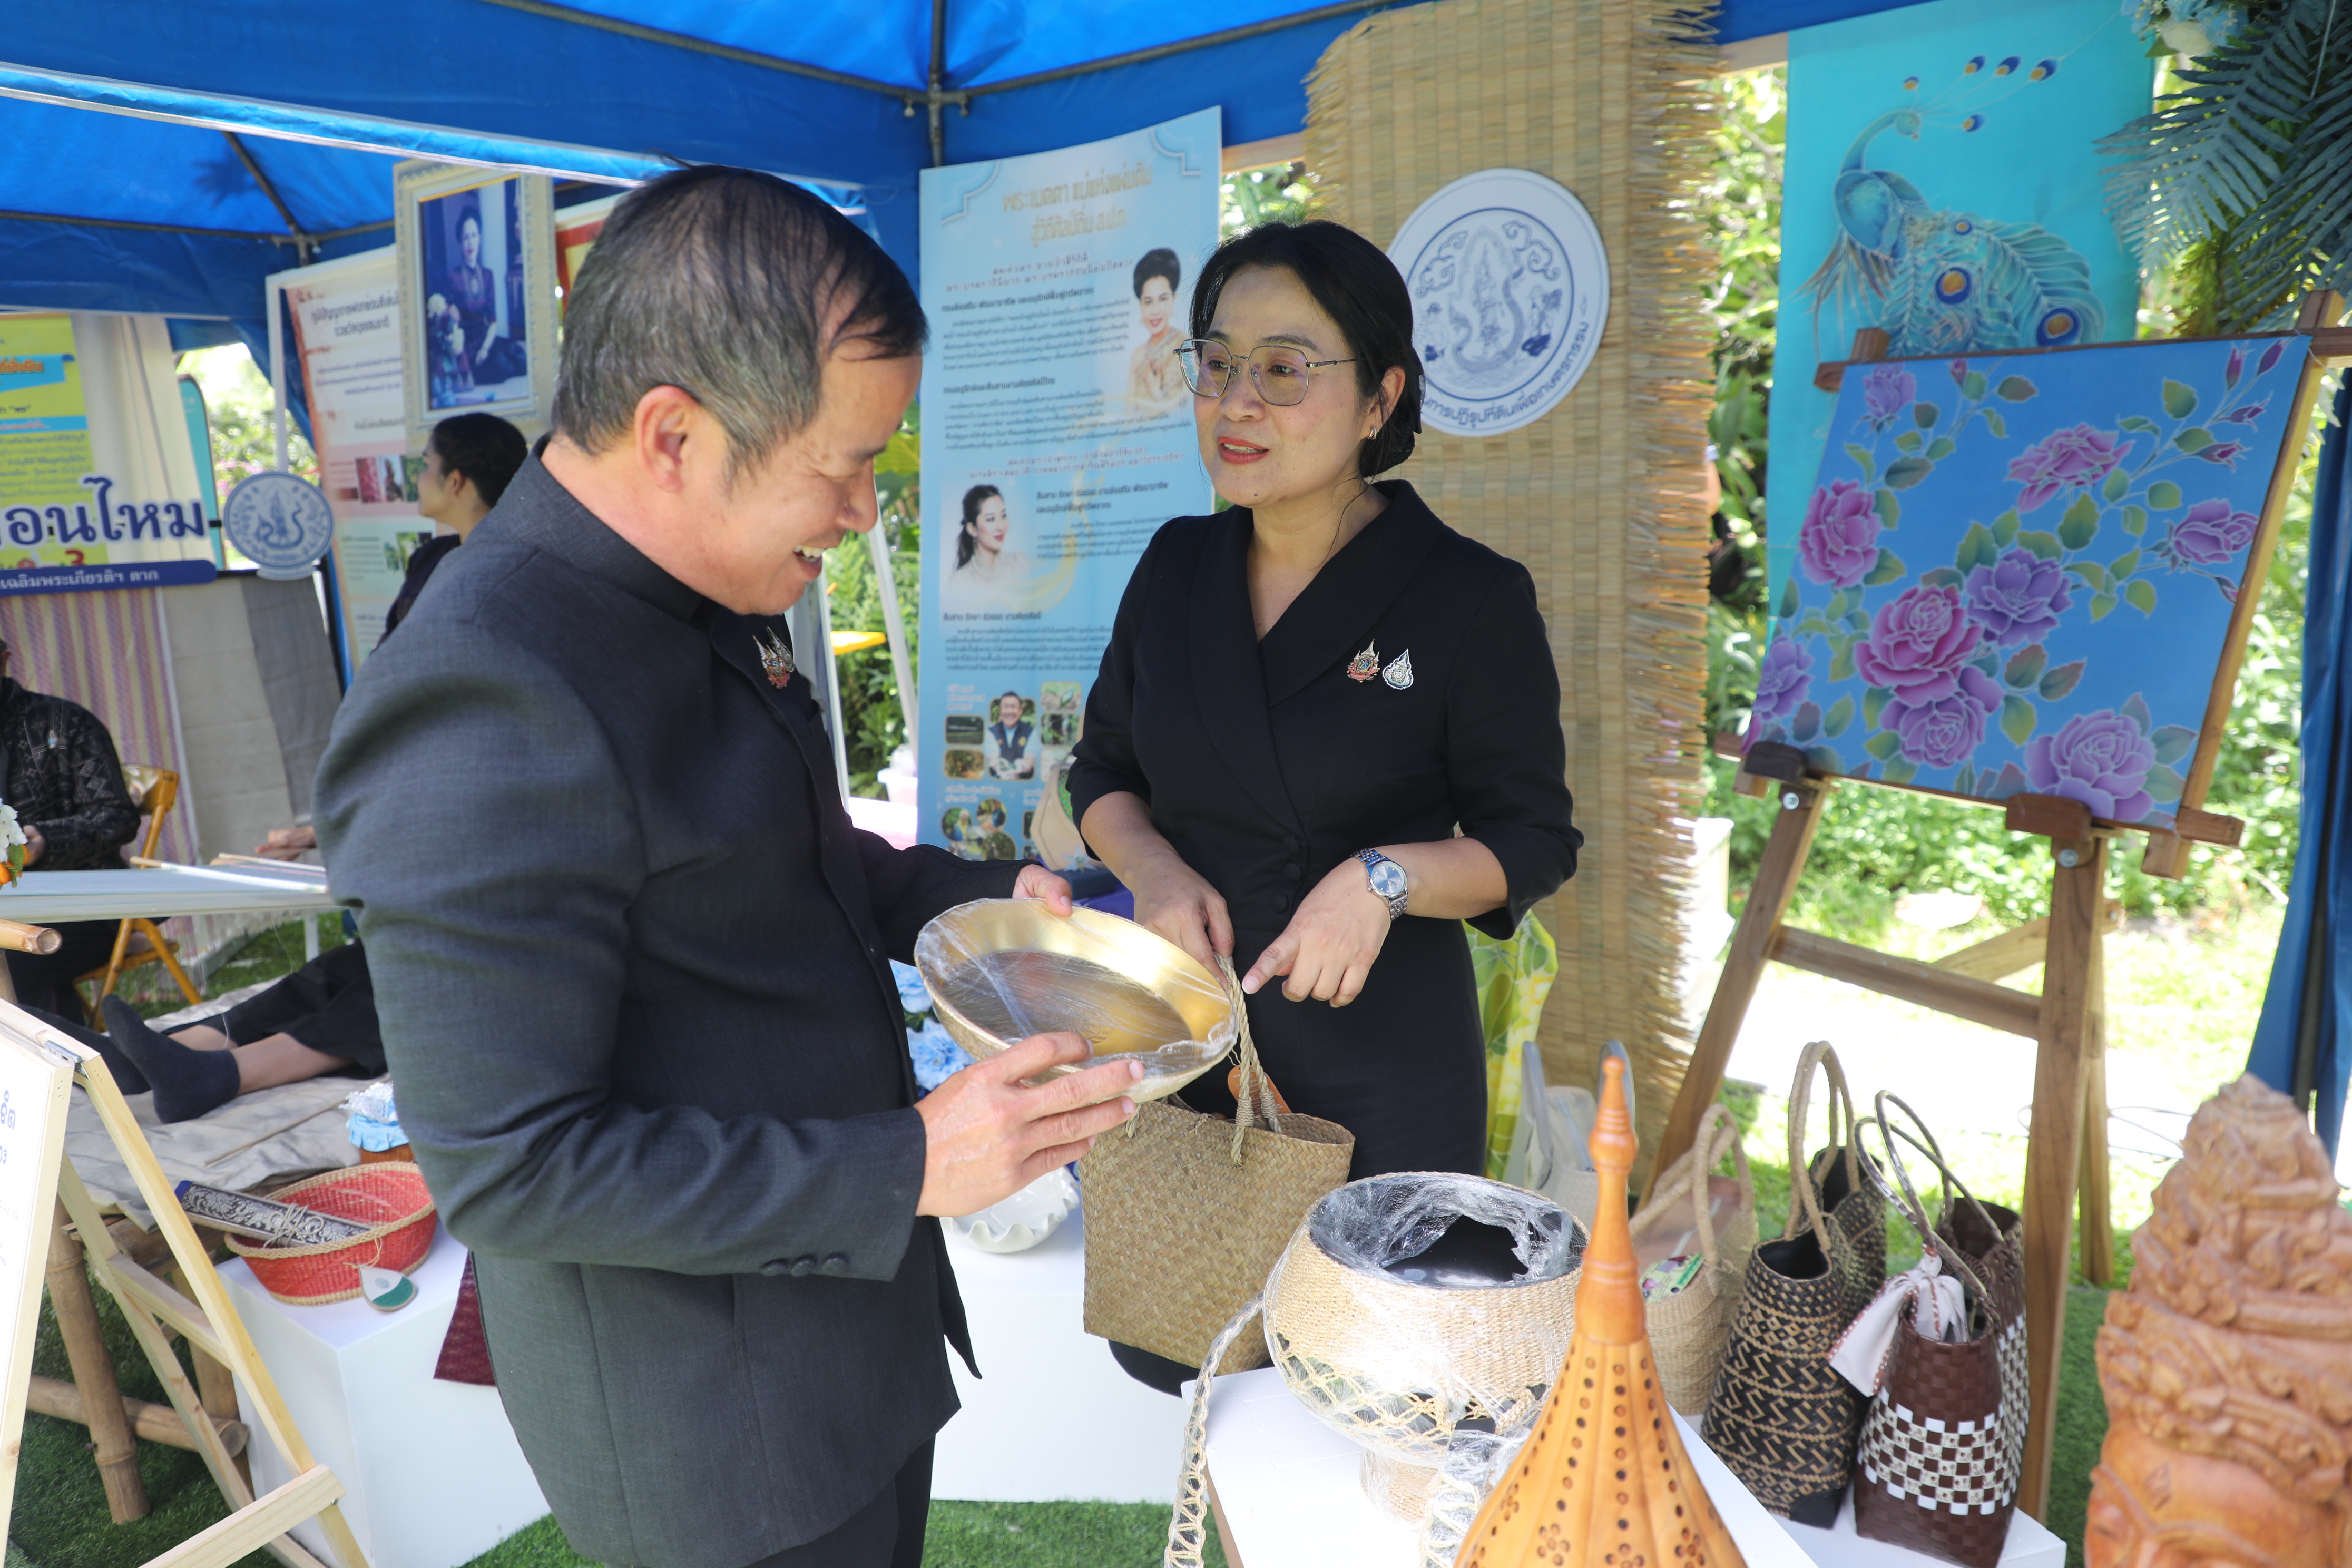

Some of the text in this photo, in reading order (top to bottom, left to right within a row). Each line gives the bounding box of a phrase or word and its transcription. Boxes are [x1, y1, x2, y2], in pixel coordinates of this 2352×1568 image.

[1002, 160, 1153, 212] พระเมตตา แม่แห่งแผ่นดิน
[0, 477, 205, 545] อนไหม
[130, 569, 159, 582] ตาก
